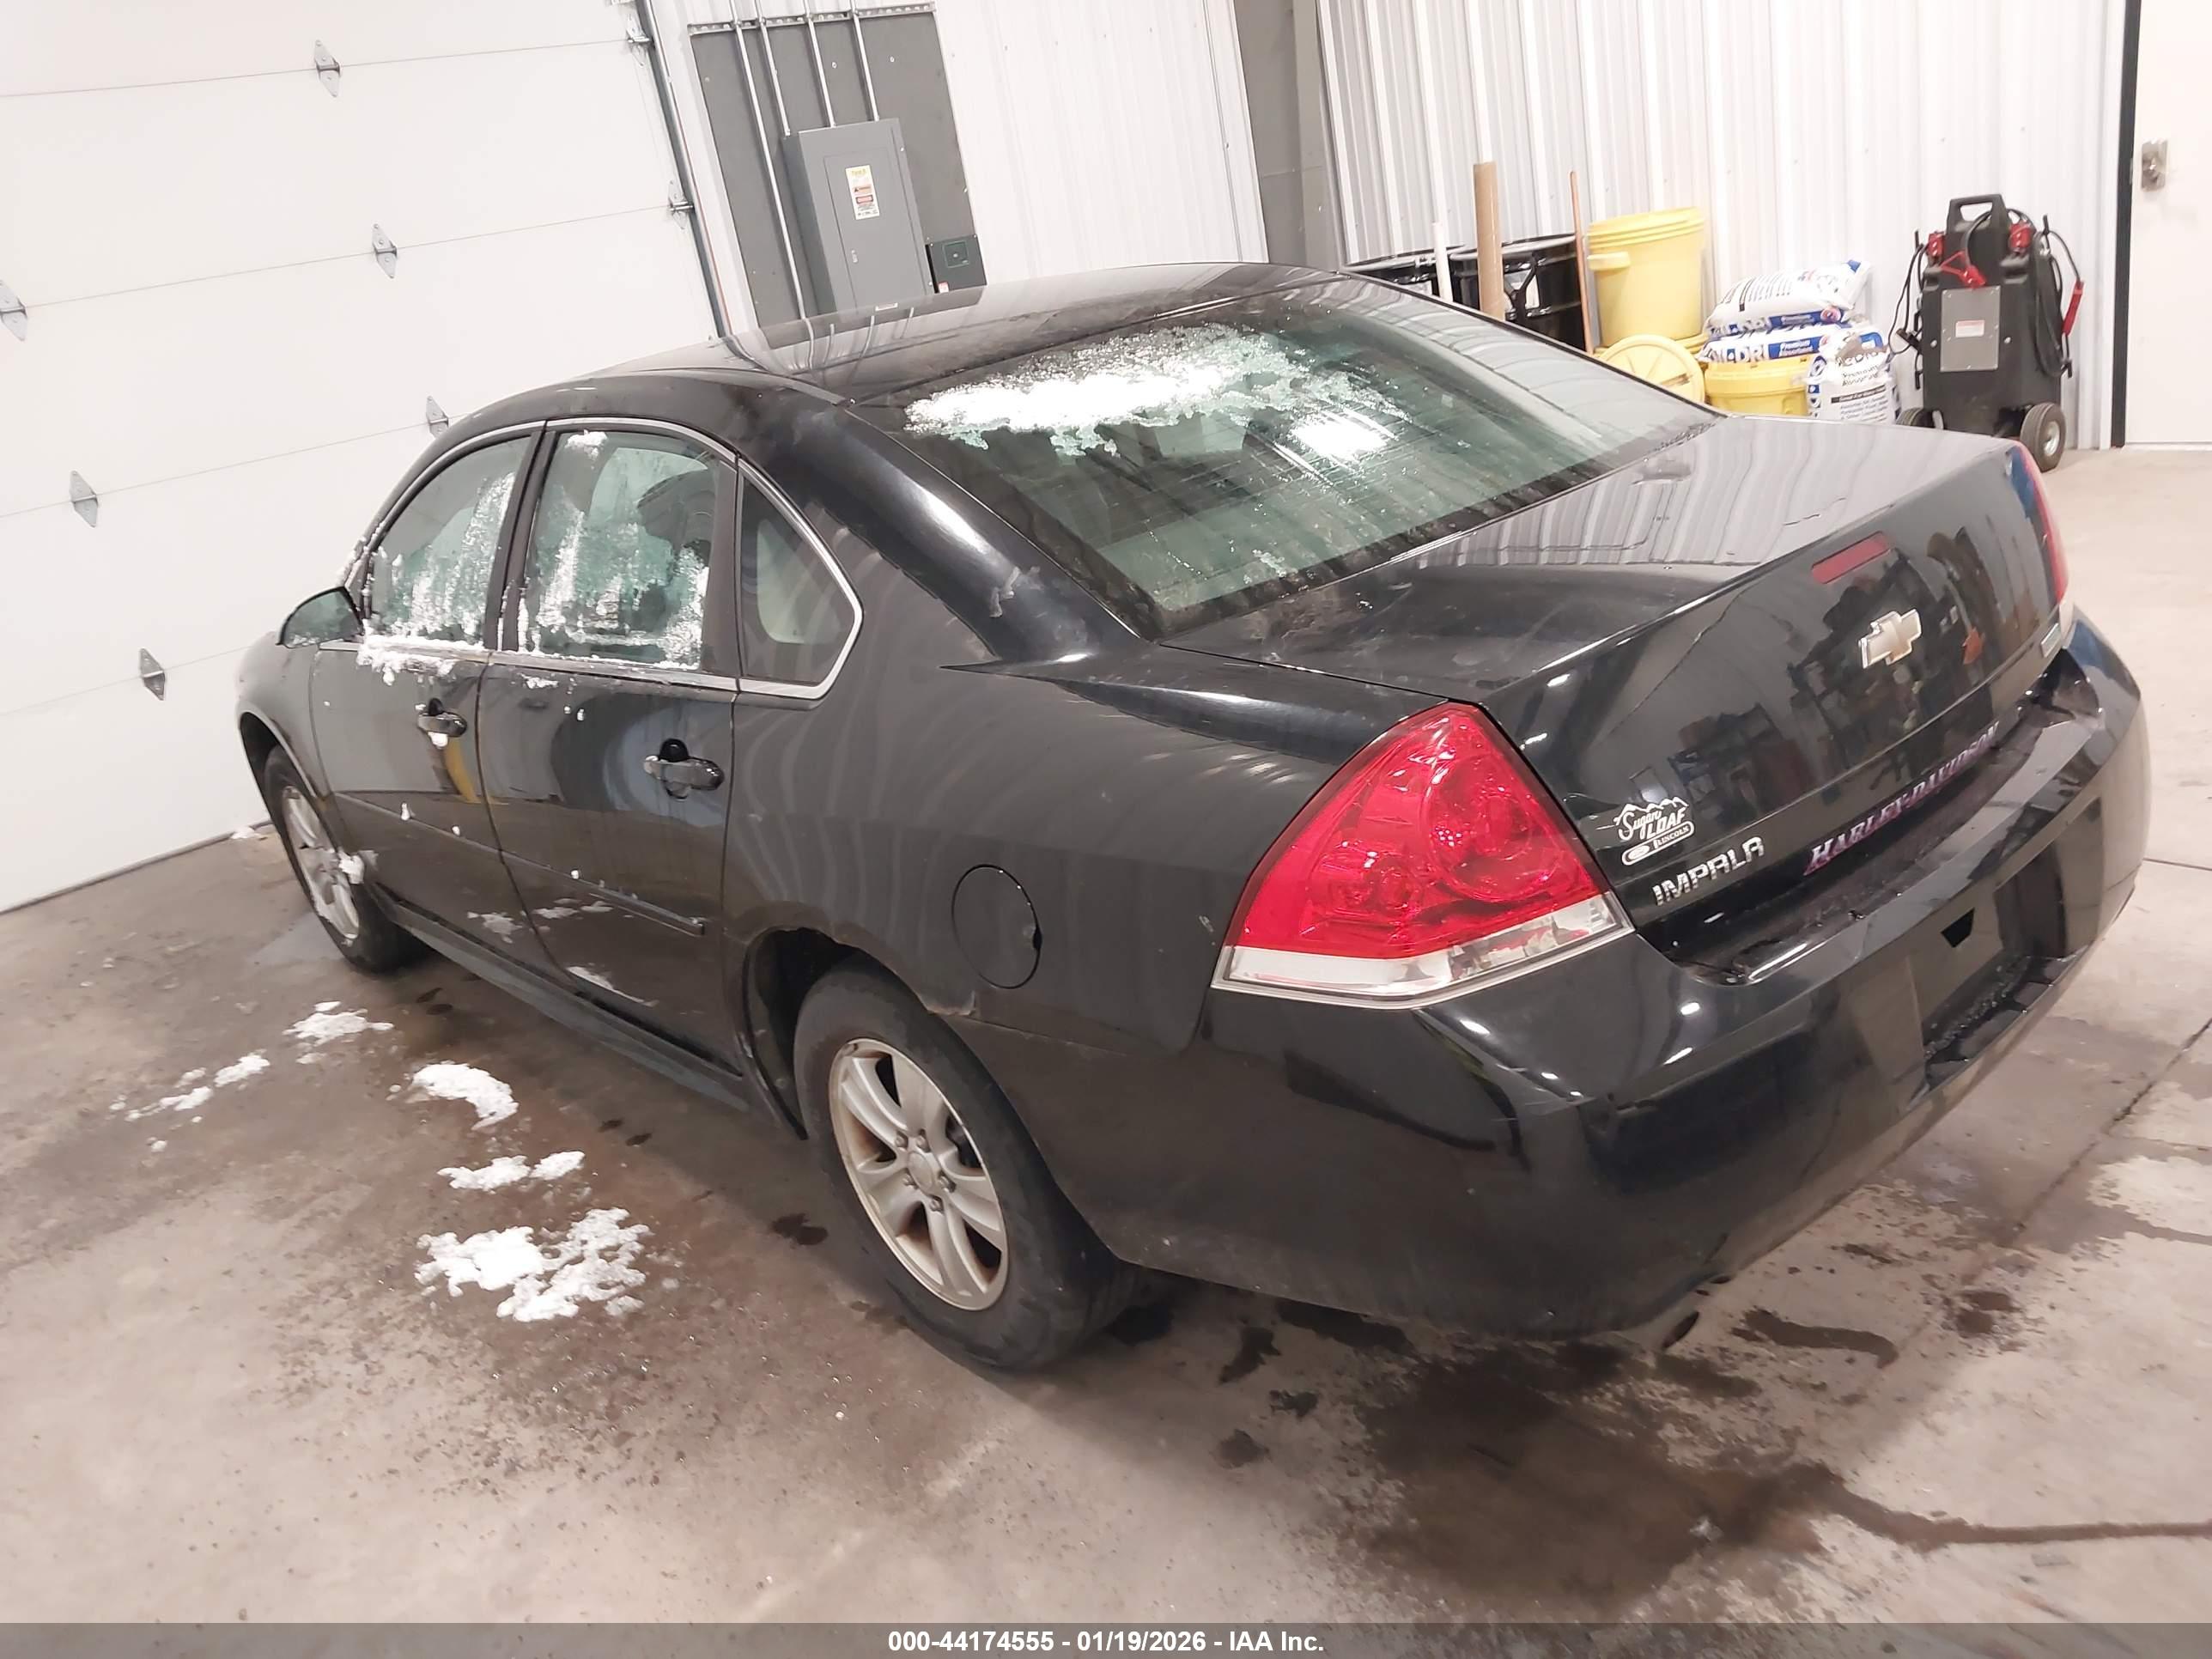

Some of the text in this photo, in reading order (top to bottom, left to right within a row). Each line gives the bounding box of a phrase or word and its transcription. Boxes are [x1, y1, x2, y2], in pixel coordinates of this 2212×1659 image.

[1619, 810, 1662, 841] Sugar
[1646, 806, 1686, 840] LOAF
[1652, 836, 1765, 906] IMPALA
